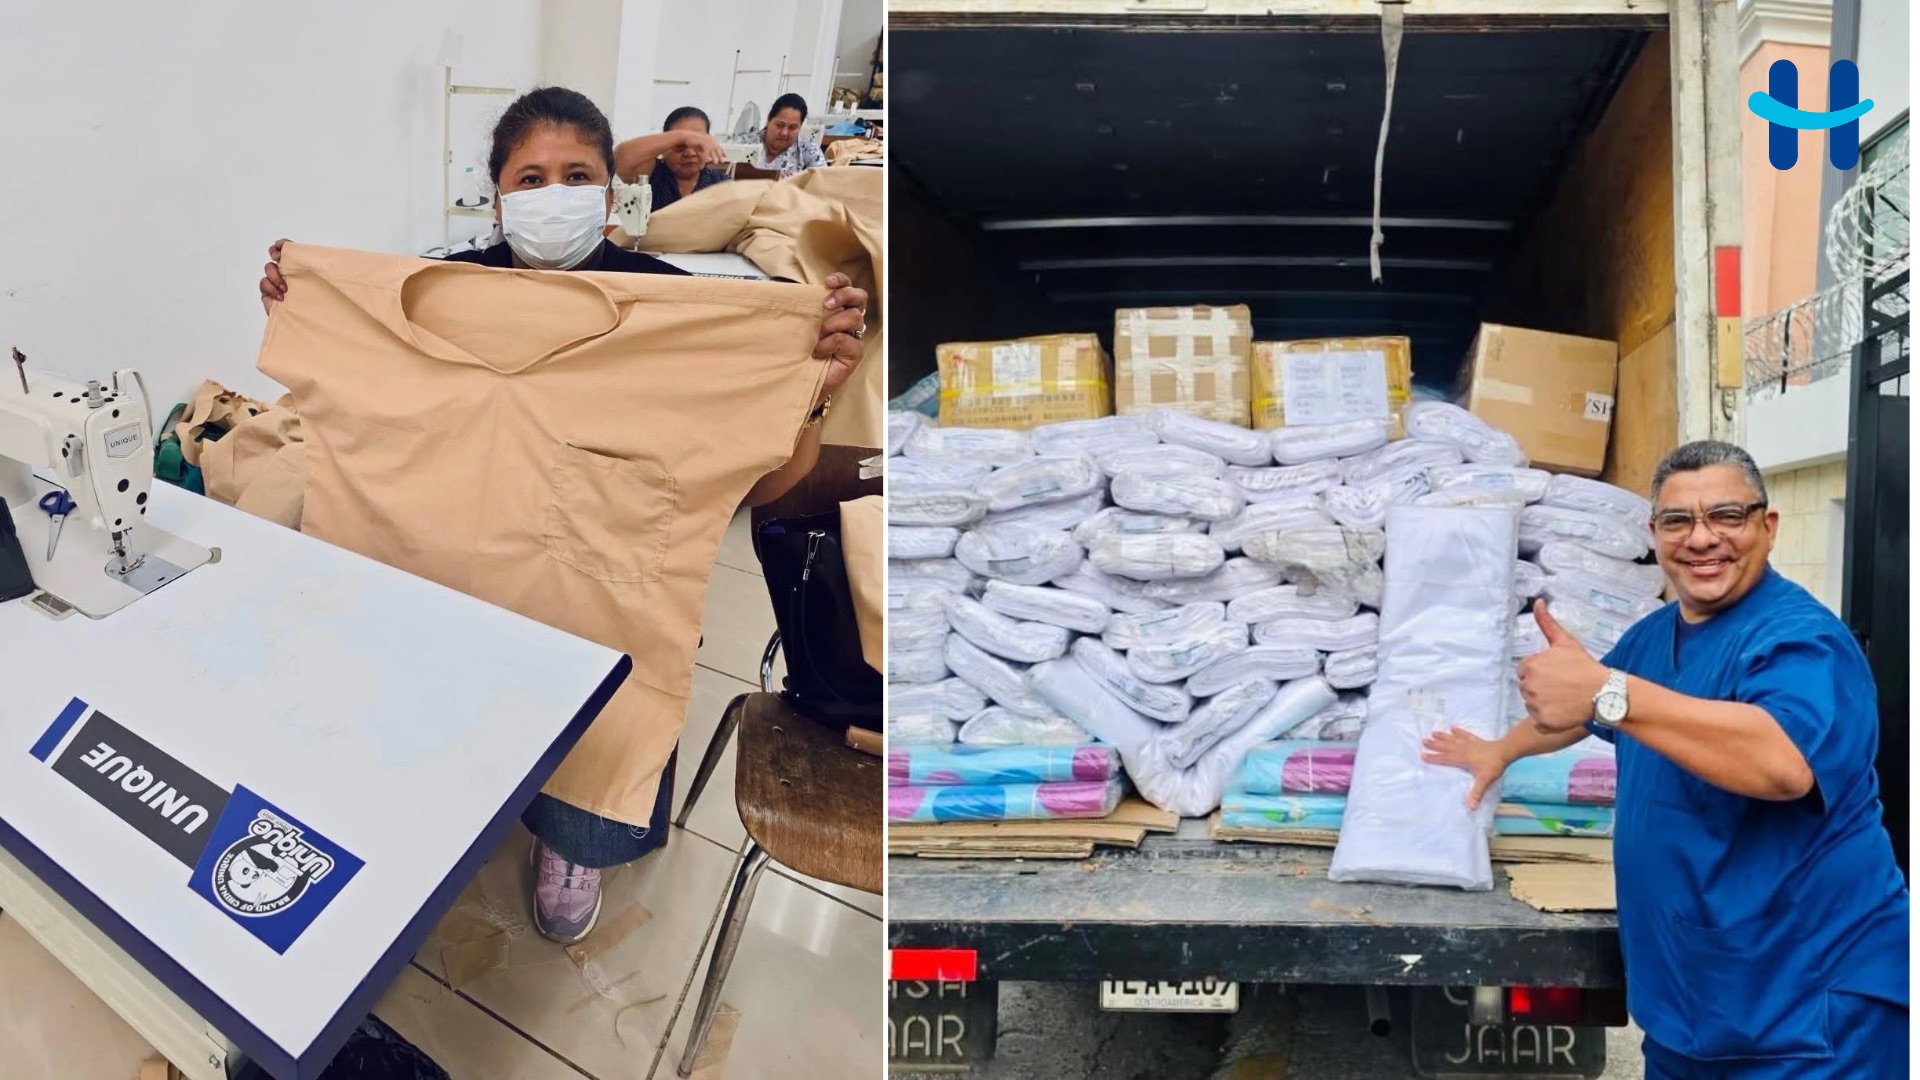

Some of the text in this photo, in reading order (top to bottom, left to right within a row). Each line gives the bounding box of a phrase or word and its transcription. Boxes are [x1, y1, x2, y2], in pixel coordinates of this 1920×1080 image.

[110, 433, 138, 448] UNIQUE
[80, 742, 209, 834] UNIQUE
[251, 819, 332, 880] Unique
[217, 852, 291, 912] BRAND OF CHINA UNIQUE
